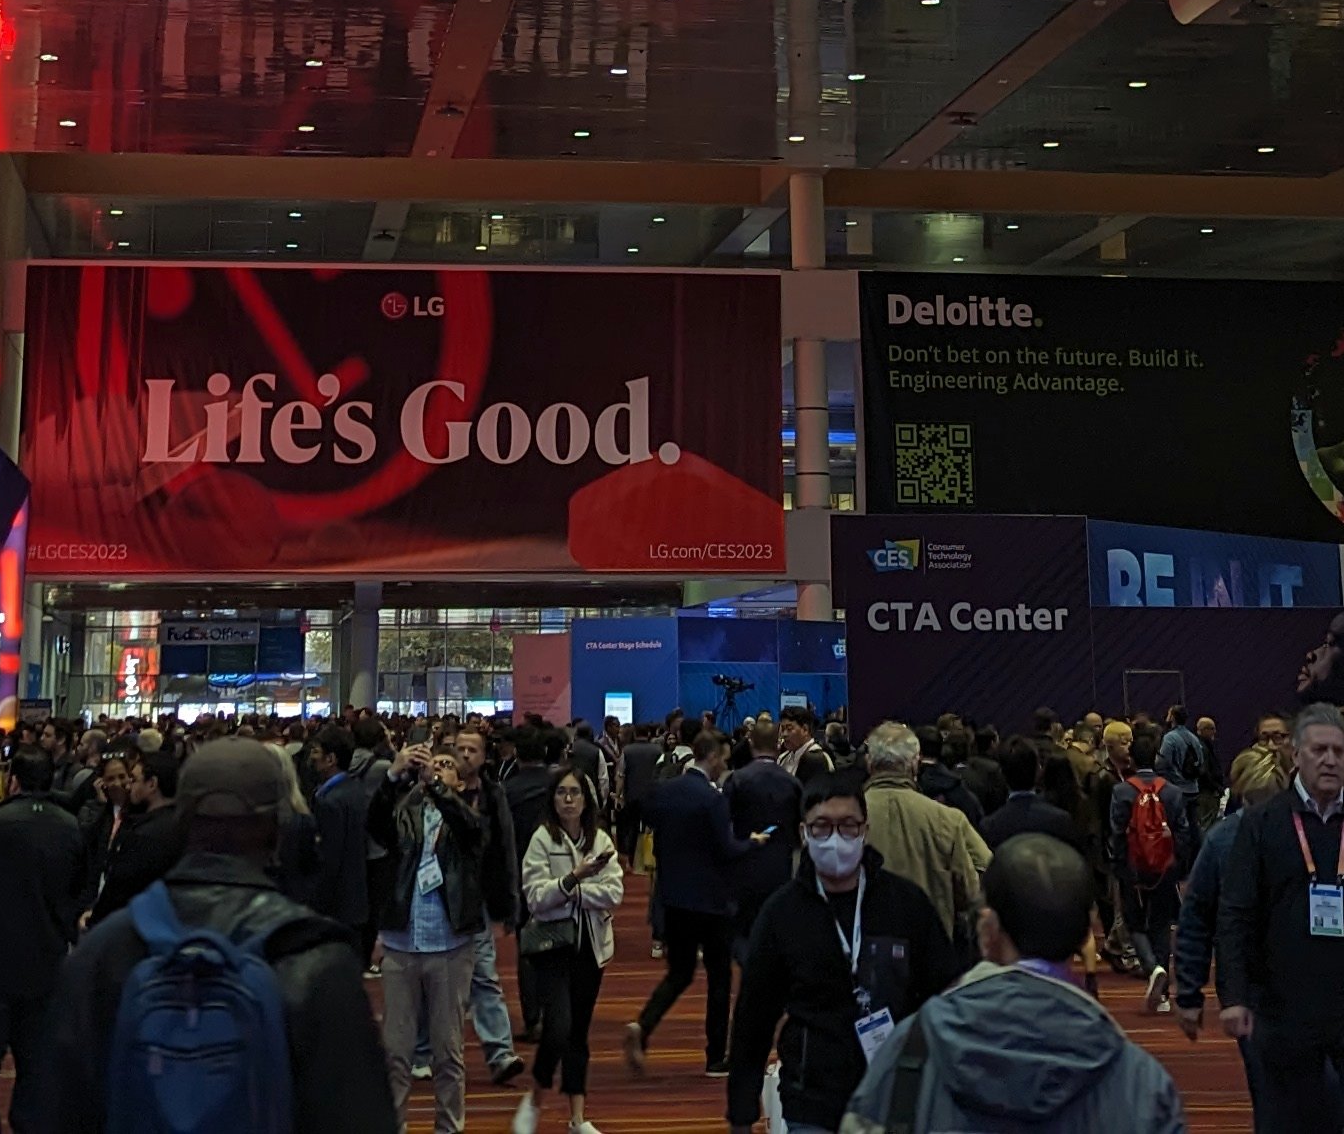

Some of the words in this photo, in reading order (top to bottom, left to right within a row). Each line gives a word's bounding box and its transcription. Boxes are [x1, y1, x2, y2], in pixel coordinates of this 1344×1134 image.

[413, 296, 445, 316] LG
[887, 294, 1044, 327] Deloitte.
[888, 345, 941, 363] Don't
[947, 345, 980, 363] bet
[985, 351, 1010, 364] on
[1017, 347, 1049, 364] the
[1055, 347, 1123, 366] future.
[1129, 349, 1178, 367] Build
[1185, 350, 1205, 367] it.
[889, 370, 1008, 394] Engineering
[1013, 372, 1126, 396] Advantage.
[141, 372, 377, 465] Life's
[400, 376, 681, 465] Good.
[28, 544, 128, 560] #LGCES2023
[649, 543, 773, 560] LG.com/CES2023
[873, 549, 910, 567] CES
[927, 551, 972, 562] Technology
[928, 560, 972, 569] Association
[867, 601, 942, 632] CTA
[949, 601, 1069, 632] Center
[167, 627, 208, 641] FedEx
